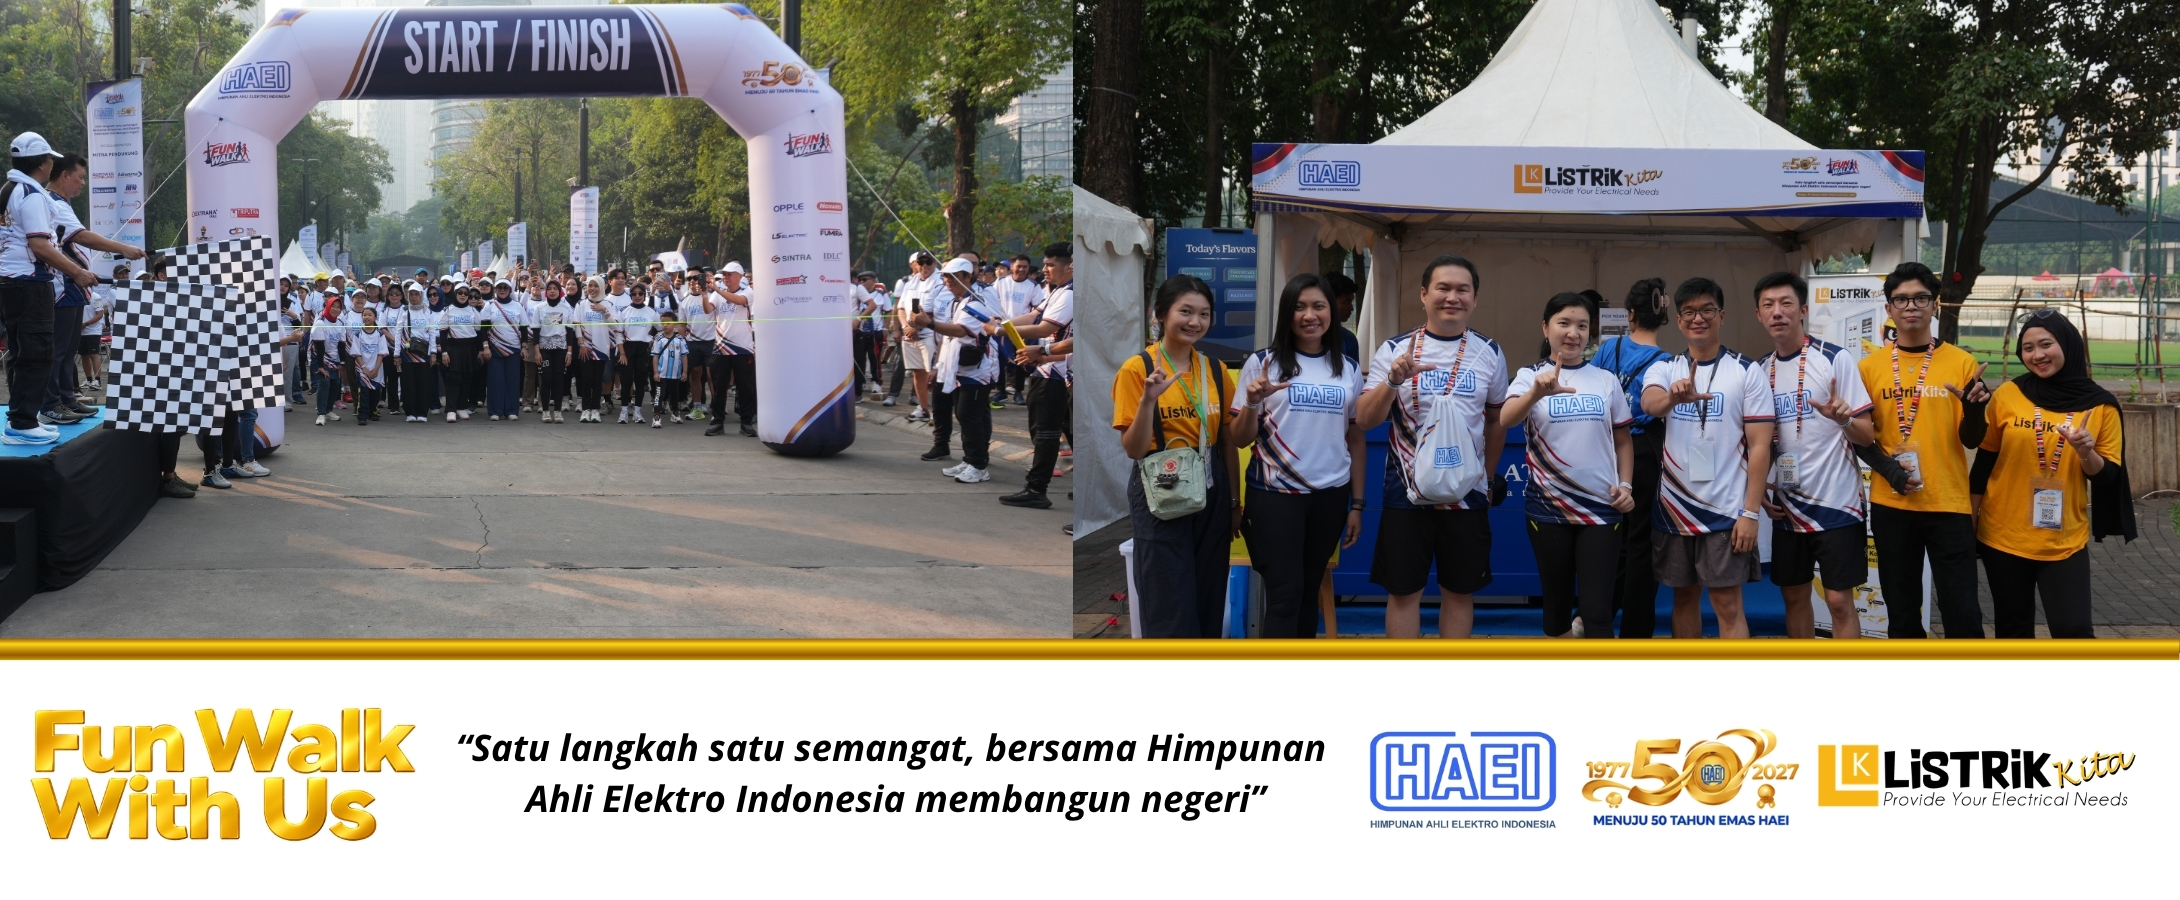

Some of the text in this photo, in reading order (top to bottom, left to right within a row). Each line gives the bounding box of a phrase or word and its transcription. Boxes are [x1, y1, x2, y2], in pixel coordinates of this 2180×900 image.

[404, 18, 631, 74] START / FINISH
[224, 65, 285, 90] HAEI
[760, 61, 802, 86] 50
[794, 134, 820, 147] FUN
[211, 143, 237, 156] FUN
[794, 143, 821, 157] WALK
[211, 153, 238, 166] WALK
[1790, 158, 1811, 170] 50
[1833, 160, 1850, 169] FUN
[1304, 164, 1356, 183] HAEI
[1624, 169, 1663, 187] Kita
[1577, 187, 1593, 195] Your
[1595, 187, 1631, 195] Electrical
[774, 203, 804, 212] OPPLE
[1186, 244, 1256, 255] Today's Flavors
[782, 254, 811, 262] SINTRA
[1294, 386, 1341, 405] HAEI
[1554, 397, 1602, 414] HAEI
